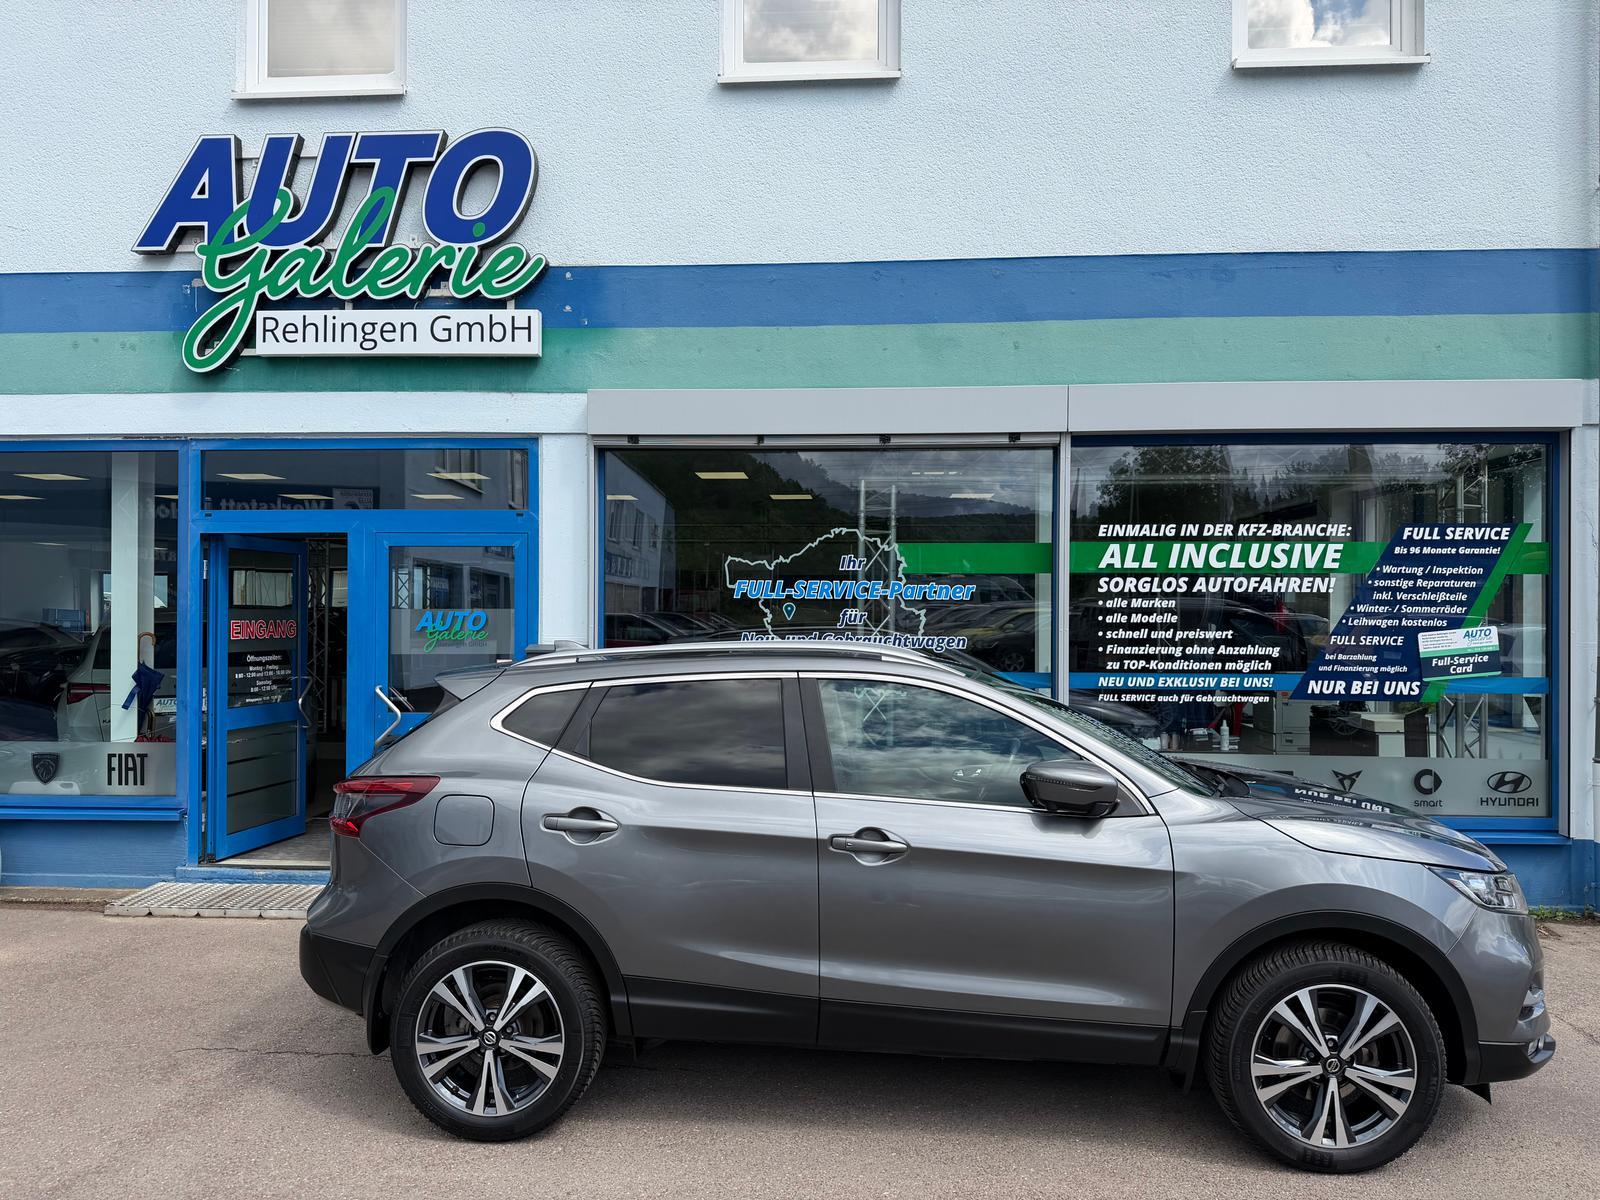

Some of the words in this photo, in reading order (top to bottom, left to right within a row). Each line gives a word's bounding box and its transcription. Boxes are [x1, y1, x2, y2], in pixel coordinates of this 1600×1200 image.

[131, 127, 539, 254] AUTO
[182, 187, 549, 373] Galerie
[261, 315, 417, 350] Rehlingen
[430, 315, 533, 343] GmbH
[1098, 525, 1176, 536] EINMALIG
[1181, 525, 1199, 536] IN
[1204, 524, 1234, 536] DER
[1238, 523, 1352, 536] KFZ-BRANCHE:
[1403, 528, 1441, 540] FULL
[1445, 528, 1510, 540] SERVICE
[1098, 544, 1158, 568] ALL
[1168, 543, 1344, 569] INCLUSIVE
[840, 554, 866, 572] Ihr
[1382, 566, 1423, 575] Wartung
[1426, 566, 1430, 574] /
[1432, 566, 1483, 575] Inspektion
[1098, 577, 1188, 593] SORGLOS
[1193, 577, 1336, 593] AUTOFAHREN!
[1374, 579, 1413, 588] sonstige
[1416, 579, 1476, 588] Reparaturen
[734, 580, 975, 600] FULL-SERVICE-Partner
[1373, 592, 1393, 600] inkl.
[1397, 592, 1467, 601] Verschleißteile
[1106, 599, 1128, 608] alle
[1131, 599, 1176, 608] Marken
[1357, 605, 1392, 613] Winter-
[1394, 605, 1399, 613] /
[1401, 605, 1467, 613] Sommerräder
[416, 610, 488, 632] AUTO
[837, 609, 867, 628] für
[1106, 613, 1128, 624] alle
[1131, 613, 1178, 624] Modelle
[1348, 618, 1399, 627] Leihwagen
[1402, 618, 1447, 627] kostenlos
[230, 620, 297, 640] EINGANG
[424, 619, 489, 653] Galerie
[1106, 629, 1148, 639] schnell
[1151, 629, 1172, 639] und
[1175, 629, 1233, 641] preiswert
[1463, 628, 1492, 639] AUTO
[1330, 636, 1357, 645] FULL
[1360, 636, 1404, 645] SERVICE
[1106, 645, 1182, 656] Finanzierung
[1186, 645, 1215, 655] ohne
[1217, 645, 1280, 657] Anzahlung
[1338, 654, 1377, 662] Barzahlung
[1432, 654, 1488, 666] Full-Service
[1106, 662, 1120, 670] zu
[1123, 660, 1222, 670] TOP-Konditionen
[1225, 660, 1272, 672] möglich
[1334, 665, 1378, 673] Finanzierung
[1380, 665, 1407, 673] möglich
[1450, 664, 1472, 674] Card
[1099, 677, 1124, 686] NEU
[1128, 677, 1155, 686] UND
[1158, 677, 1217, 687] EXKLUSIV
[1220, 678, 1241, 687] BEI
[1244, 678, 1273, 687] UNS!
[1307, 680, 1346, 695] NUR
[1350, 680, 1378, 695] BEI
[1384, 681, 1420, 695] UNS
[1099, 694, 1117, 702] FULL
[1120, 694, 1155, 702] SERVICE
[1158, 694, 1177, 702] auch
[1179, 694, 1194, 703] für
[1196, 694, 1269, 703] Gebrauchtwagen
[107, 753, 148, 786] FIAT
[1414, 799, 1442, 808] smart
[1480, 797, 1538, 806] HYUNDAI
